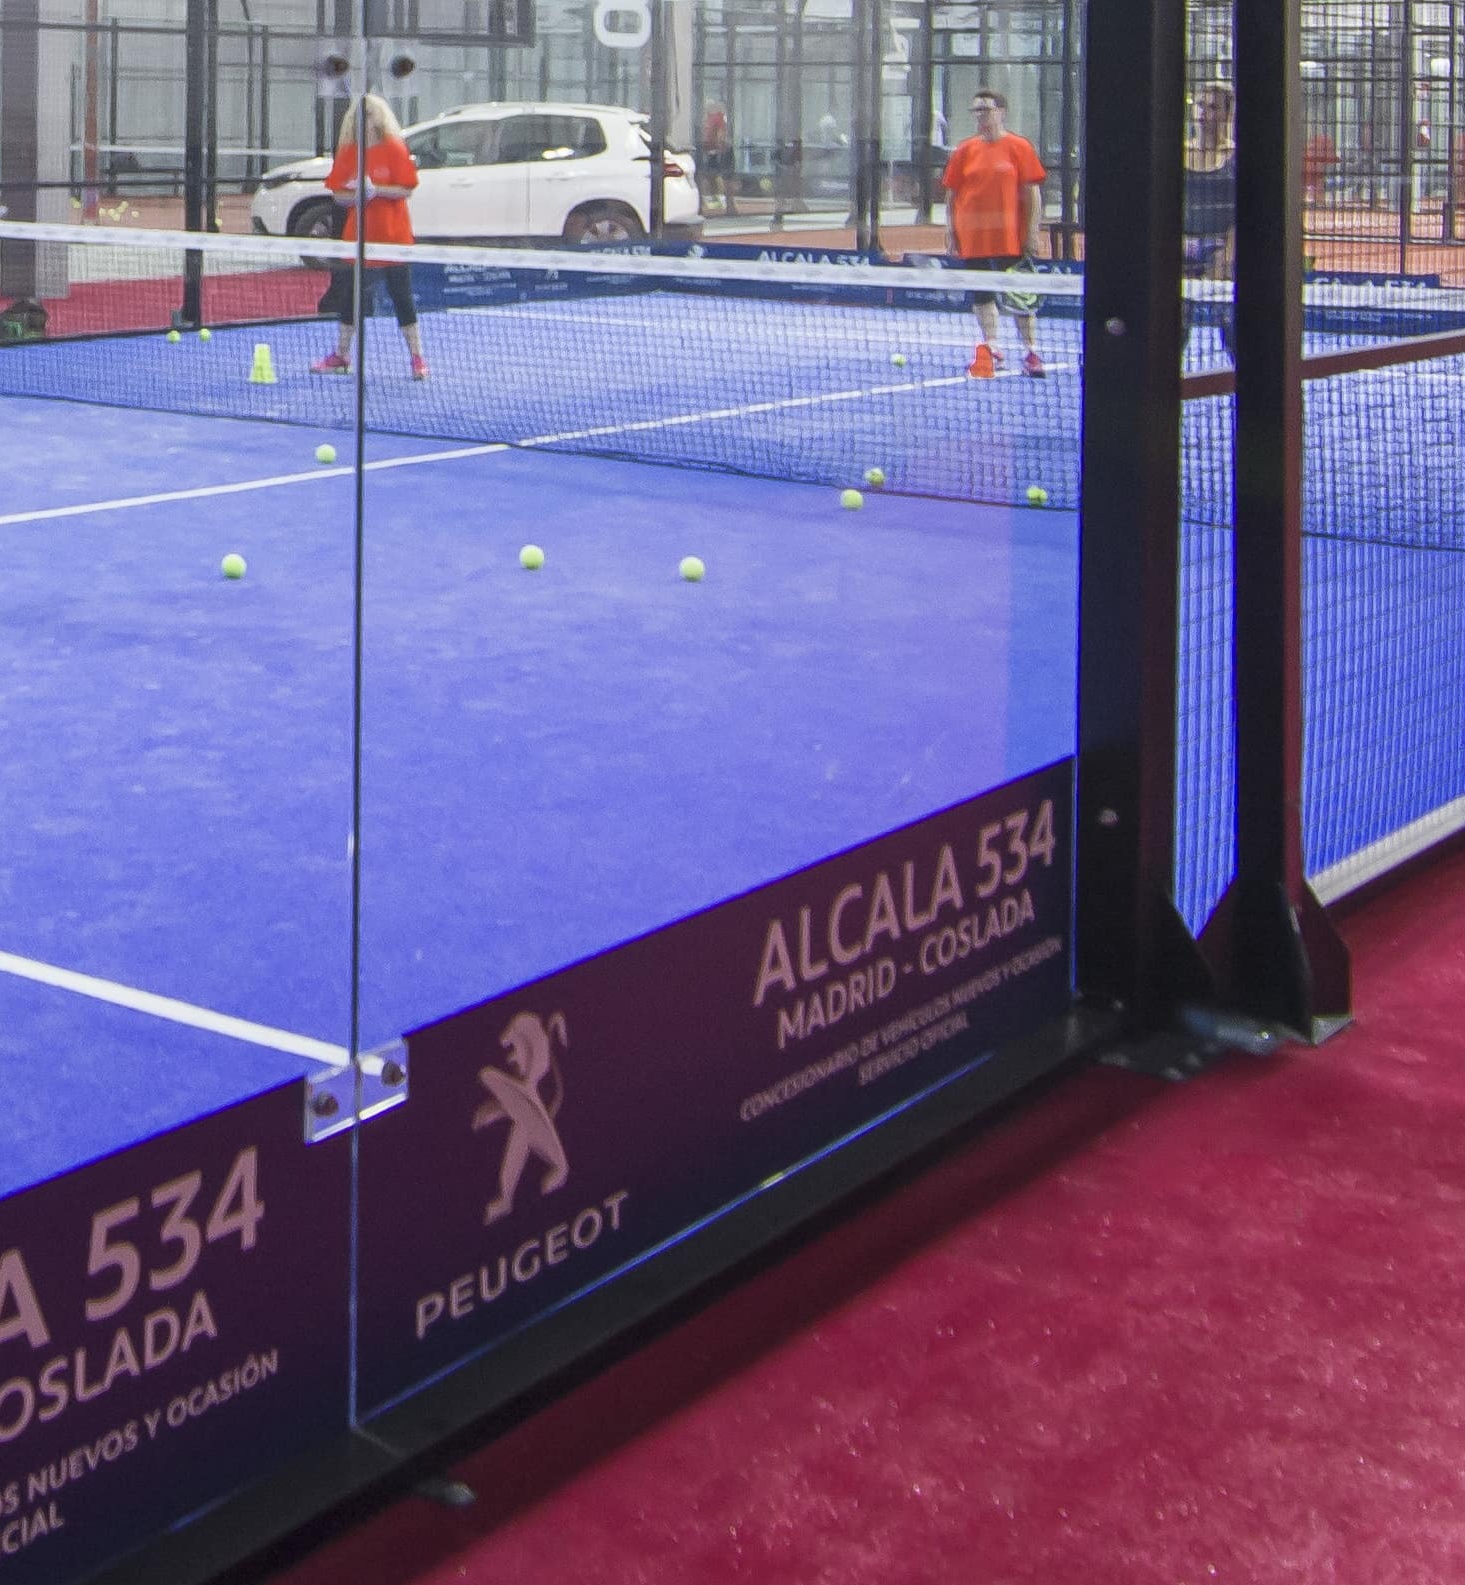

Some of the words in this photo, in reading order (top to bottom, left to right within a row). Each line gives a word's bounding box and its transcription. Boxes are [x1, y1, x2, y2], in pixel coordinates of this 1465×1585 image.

[753, 843, 964, 1008] ALCALA
[975, 799, 1057, 898] 534
[777, 957, 896, 1051] MADRID
[919, 888, 1035, 976] COSLADA
[84, 1145, 265, 1322] 534
[415, 1188, 631, 1341] PEUGEOT
[26, 1418, 138, 1503] NUEVOS
[144, 1407, 162, 1440] Y
[166, 1347, 279, 1428] OCASIÓN
